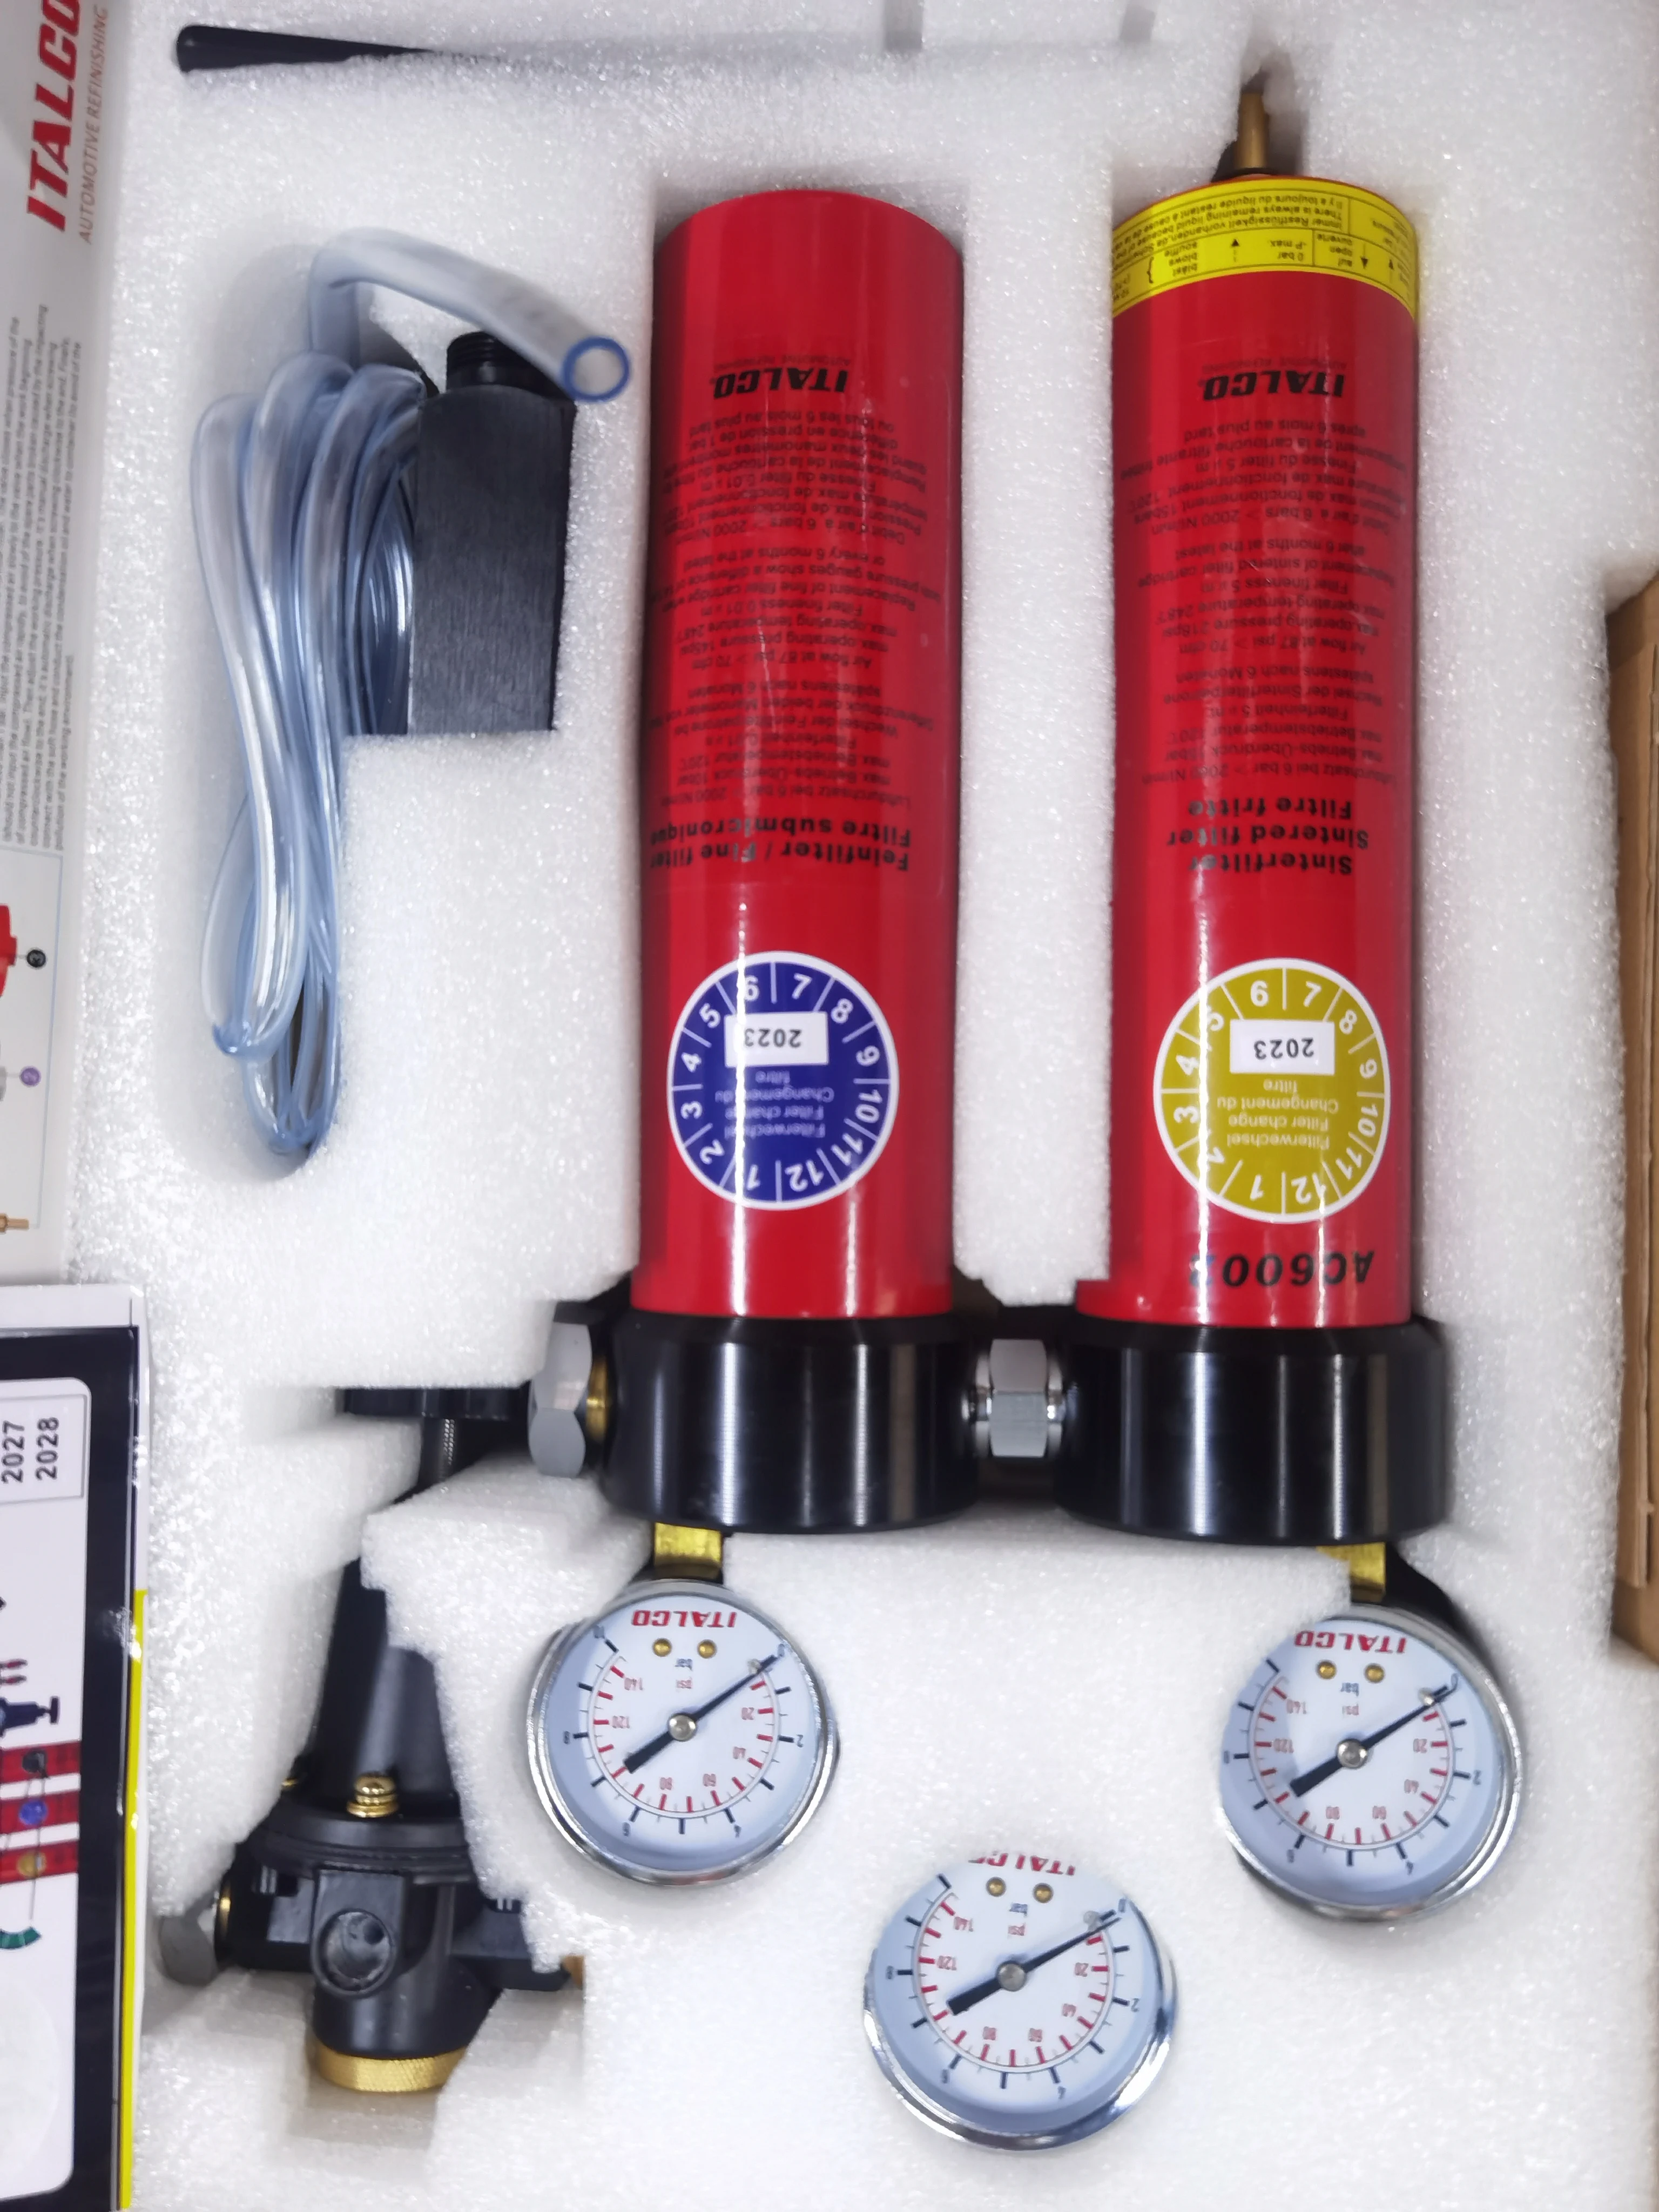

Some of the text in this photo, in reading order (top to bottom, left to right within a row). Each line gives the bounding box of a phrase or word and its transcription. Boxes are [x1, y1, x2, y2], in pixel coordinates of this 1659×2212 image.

[25, 0, 80, 232] ITALCO
[78, 5, 107, 244] AUTOMOTIVE REFINISHING
[1219, 197, 1256, 208] liquide
[1263, 204, 1299, 215] always
[1275, 195, 1318, 206] toujours
[1176, 217, 1204, 231] liquid
[1206, 208, 1260, 221] remaining
[1314, 208, 1341, 220] There
[1277, 252, 1294, 260] bar
[713, 367, 849, 399] ITALCO
[1203, 370, 1345, 402] ITALCO
[1277, 797, 1351, 820] Filtre
[650, 818, 911, 848] Filtre submicronique
[1166, 825, 1368, 850] Sintered filter
[650, 847, 693, 868] filter
[701, 842, 755, 863] Fine
[781, 842, 909, 871] Feinfilter
[1187, 853, 1352, 875] Sinterfilter
[742, 975, 759, 1001] 6
[792, 974, 812, 999] 7
[1250, 981, 1269, 1006] 6
[1304, 982, 1321, 1007] 7
[699, 1003, 720, 1028] 5
[831, 998, 853, 1024] 8
[1338, 1009, 1358, 1035] 8
[743, 1028, 802, 1048] 2023
[1253, 1037, 1314, 1060] 2023
[681, 1052, 702, 1073] 4
[855, 1045, 880, 1066] 9
[1176, 1054, 1199, 1076] 4
[1359, 1060, 1377, 1078] 9
[1263, 1079, 1297, 1094] filtre
[680, 1101, 703, 1120] 3
[855, 1089, 882, 1123] 10
[1174, 1105, 1196, 1123] 3
[1217, 1095, 1339, 1114] Changement du
[1228, 1114, 1328, 1131] Filter change
[1358, 1104, 1377, 1137] 10
[700, 1139, 725, 1164] 2
[831, 1133, 863, 1166] 11
[1226, 1134, 1330, 1149] Filterwechsel
[1335, 1148, 1363, 1179] 11
[746, 1164, 761, 1190] 1
[784, 1160, 824, 1192] 12
[1250, 1175, 1266, 1200] 1
[1291, 1172, 1327, 1204] 12
[1, 1420, 25, 1484] 2027
[35, 1417, 59, 1481] 2028
[631, 1609, 738, 1628] ITALCO
[1293, 1630, 1407, 1654] ITALCO
[1340, 1682, 1360, 1696] bar
[1286, 1700, 1307, 1714] 140
[1341, 1704, 1360, 1717] psi
[794, 1735, 804, 1748] 2
[1273, 1738, 1293, 1754] 120
[1413, 1738, 1427, 1753] 20
[1472, 1770, 1482, 1785] 2
[1372, 1805, 1387, 1819] 60
[936, 1955, 957, 1971] 120
[1074, 1963, 1089, 1976] 20
[1130, 1998, 1140, 2012] 2
